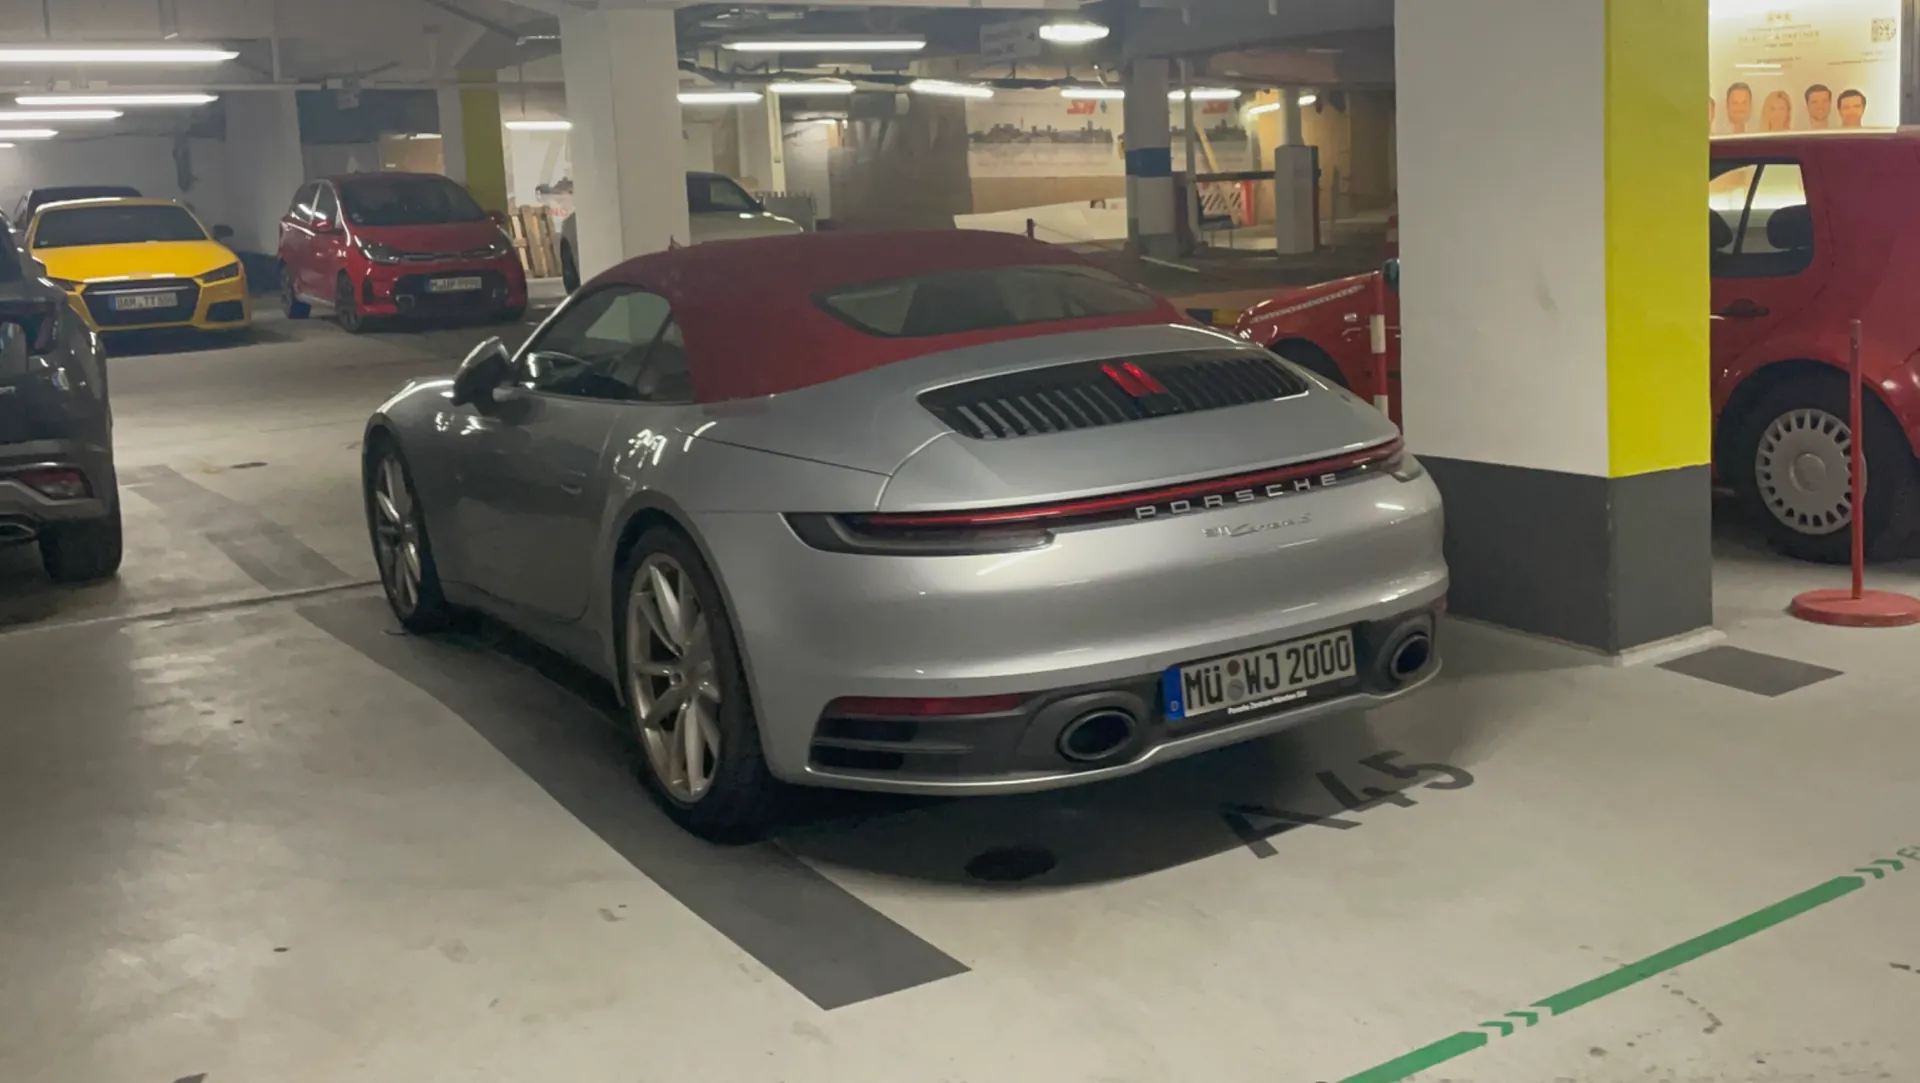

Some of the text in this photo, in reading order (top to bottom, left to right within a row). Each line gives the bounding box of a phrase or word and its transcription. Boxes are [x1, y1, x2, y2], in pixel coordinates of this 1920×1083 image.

[1135, 473, 1337, 519] PORSCHE
[1243, 652, 1280, 695] WJ
[1286, 635, 1352, 685] 2000
